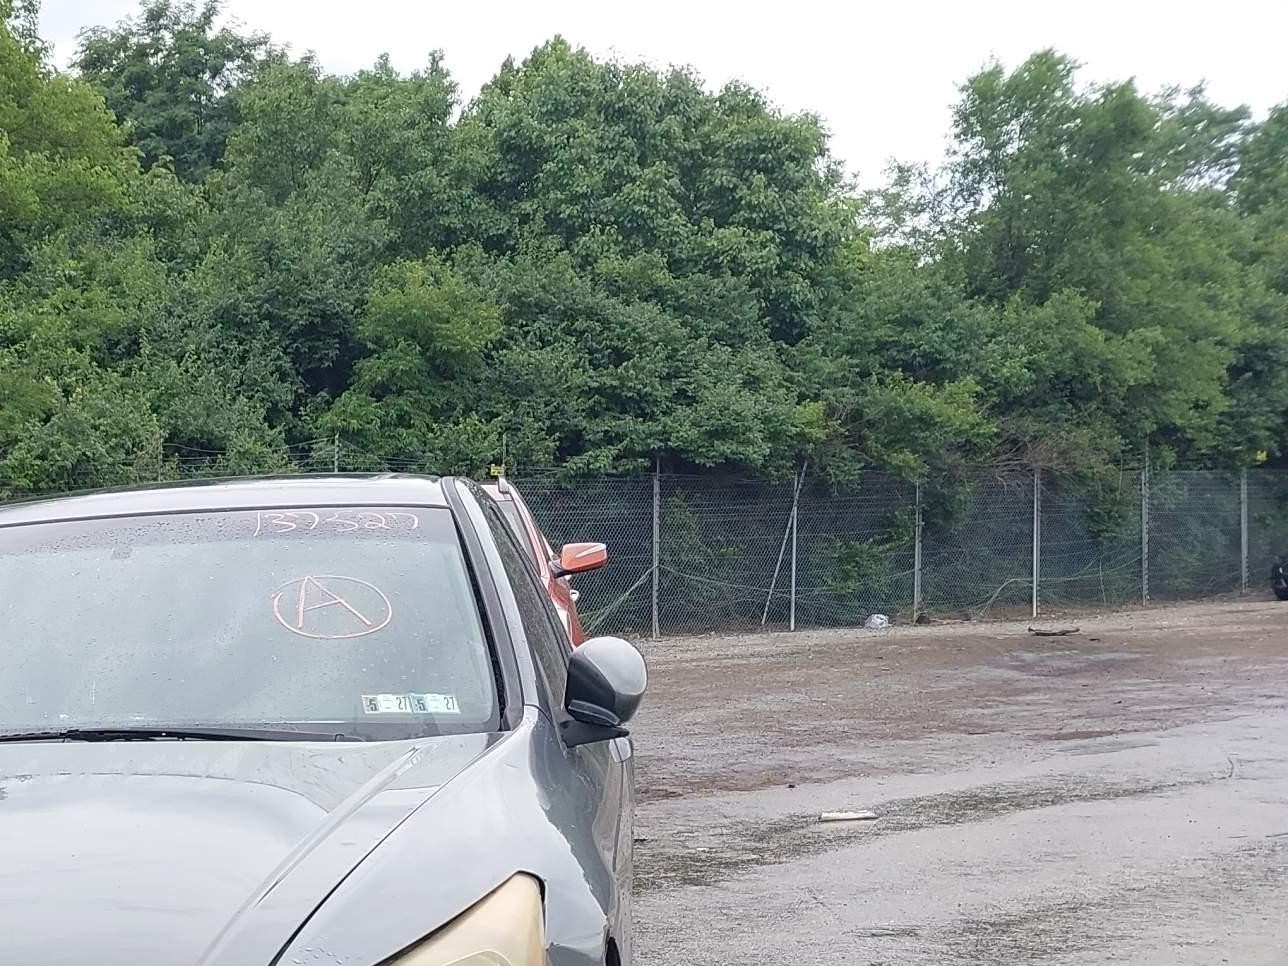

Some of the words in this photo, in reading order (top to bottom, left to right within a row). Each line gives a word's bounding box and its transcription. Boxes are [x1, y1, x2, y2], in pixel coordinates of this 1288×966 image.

[297, 575, 372, 629] A
[396, 696, 408, 711] 27
[443, 696, 455, 711] 27
